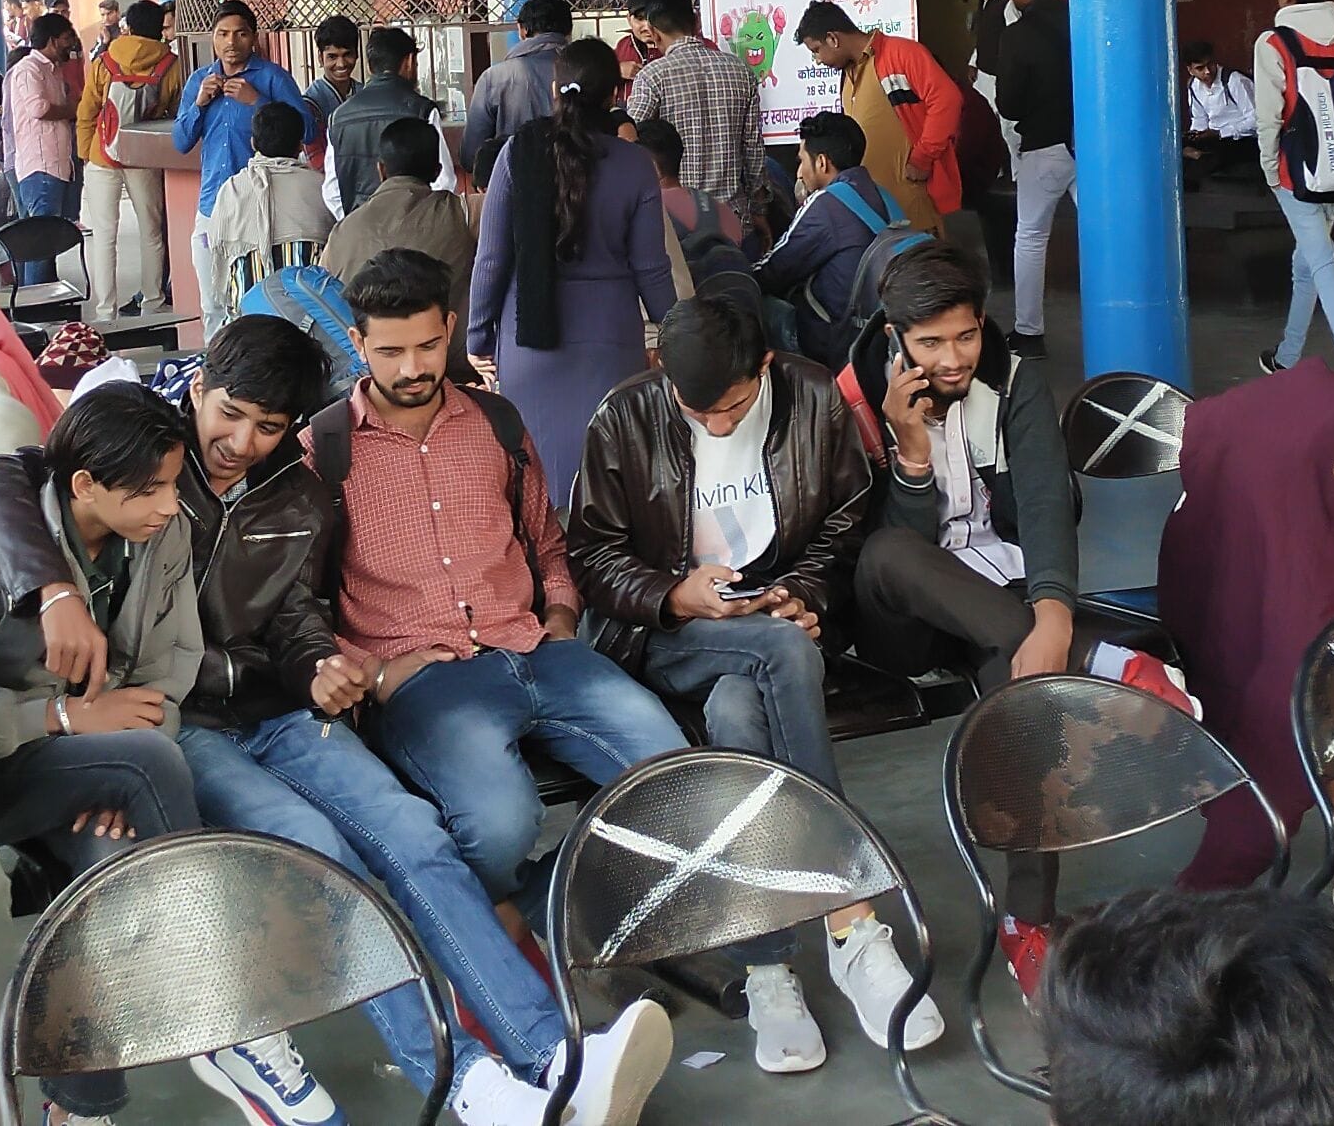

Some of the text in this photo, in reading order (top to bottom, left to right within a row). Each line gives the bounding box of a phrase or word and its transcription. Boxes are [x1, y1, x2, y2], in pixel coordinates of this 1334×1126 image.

[806, 81, 838, 96] 28 से 42
[696, 483, 738, 509] lvin
